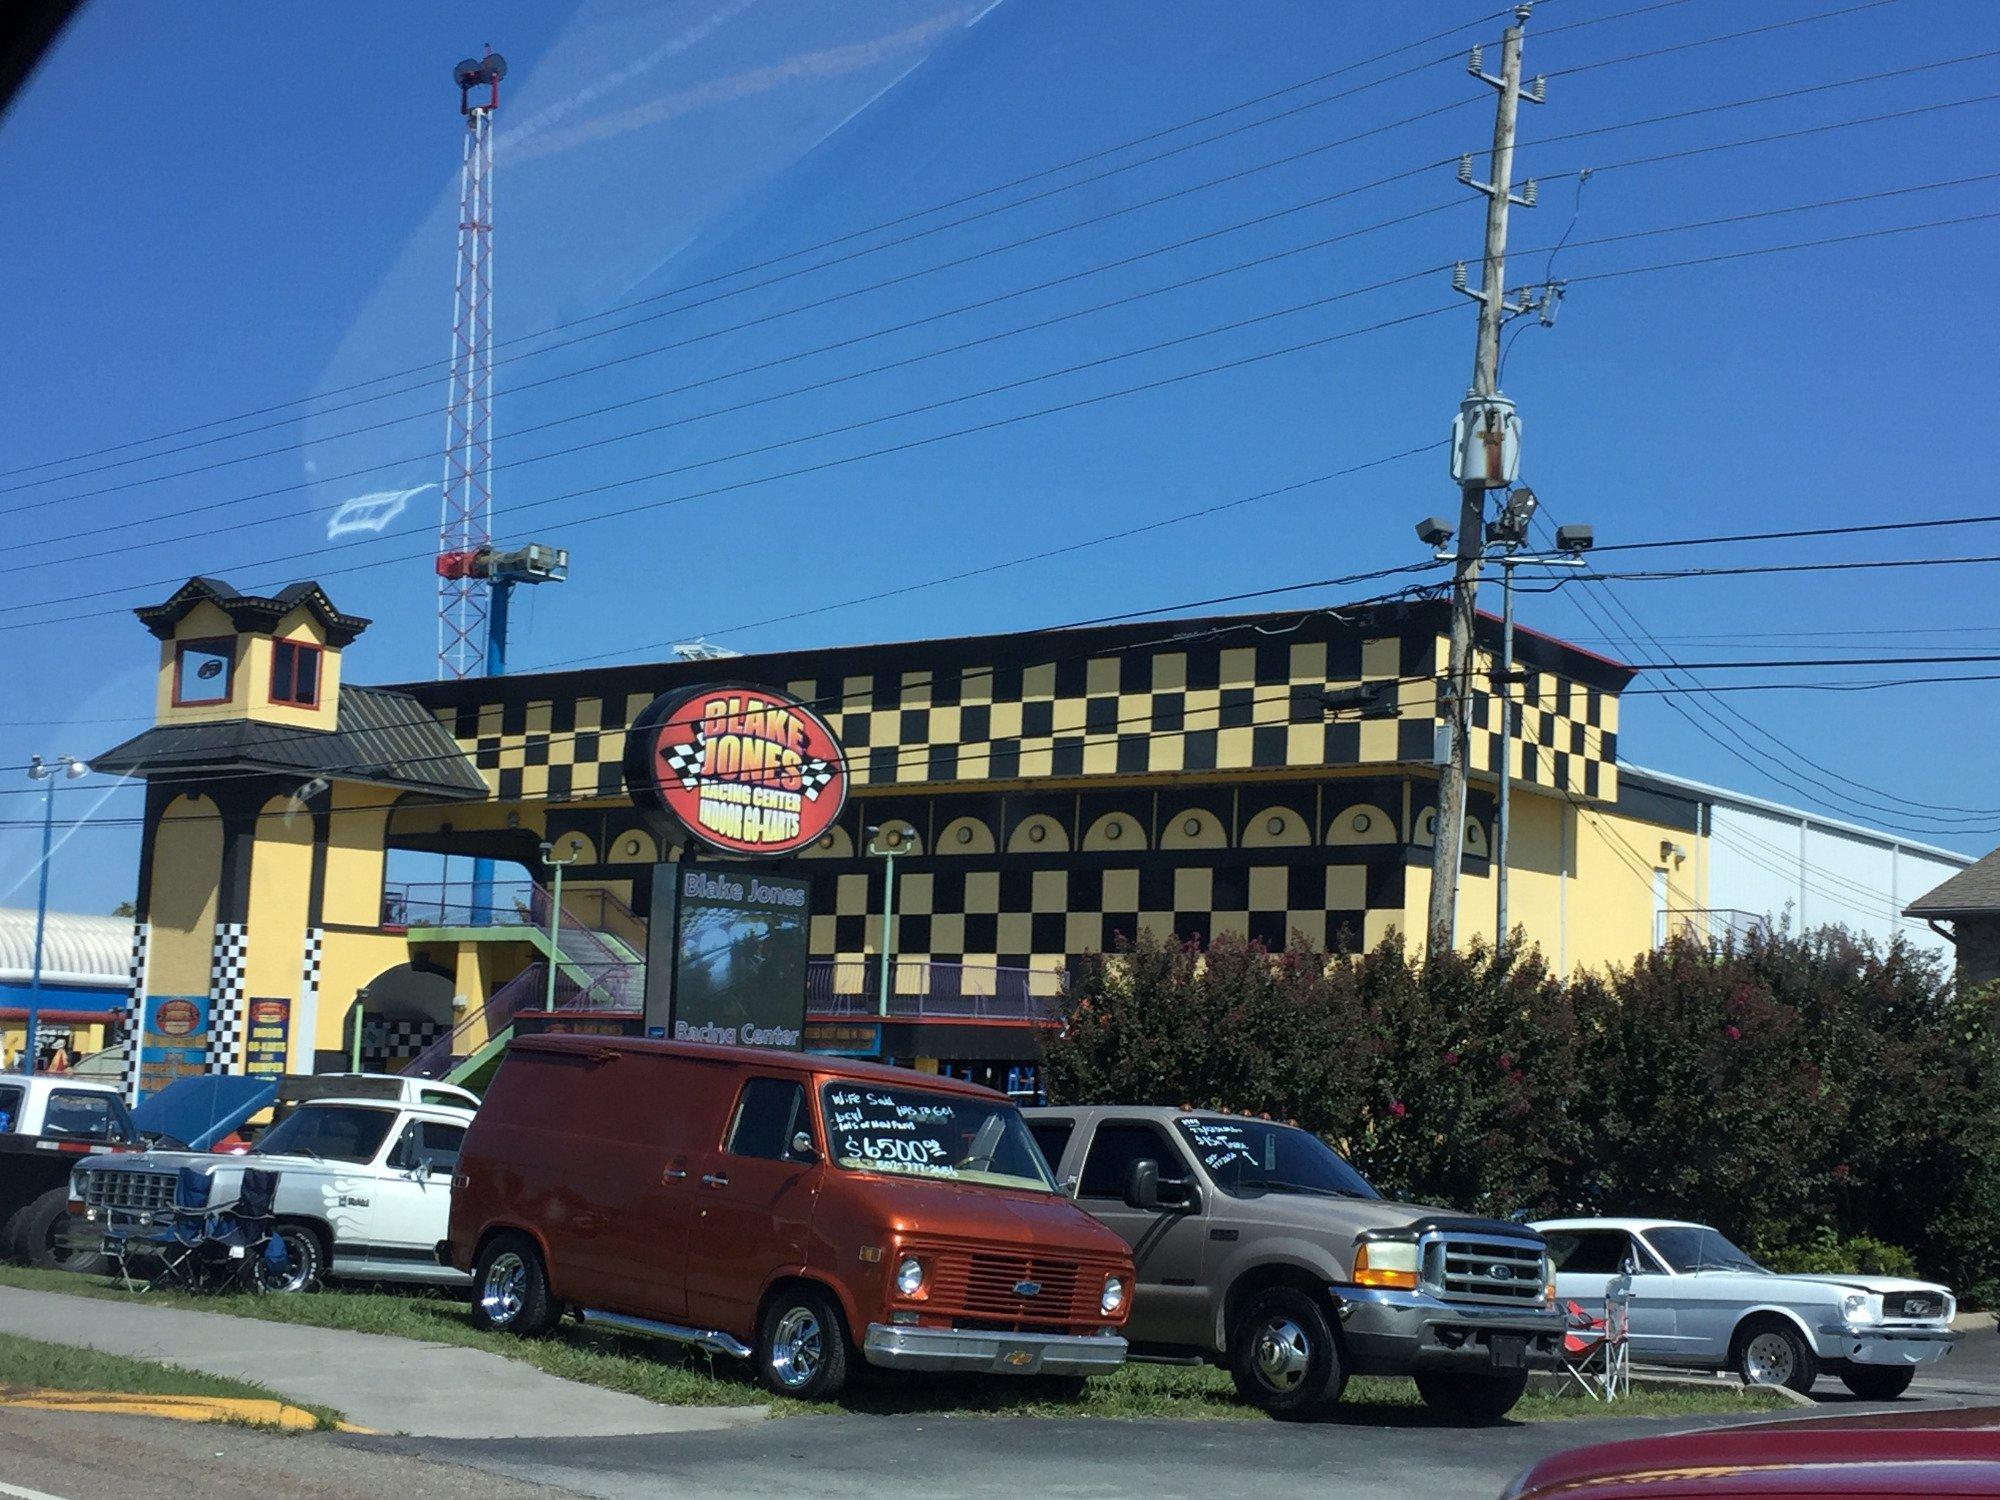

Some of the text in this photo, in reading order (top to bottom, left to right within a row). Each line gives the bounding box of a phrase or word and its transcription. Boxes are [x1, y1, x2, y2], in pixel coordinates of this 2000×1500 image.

[704, 698, 806, 751] BLAKE
[701, 734, 803, 790] JONES
[700, 779, 802, 812] RACING CENTER
[683, 873, 806, 907] Blake Jones
[675, 1020, 737, 1046] Racing
[740, 1022, 800, 1046] Center
